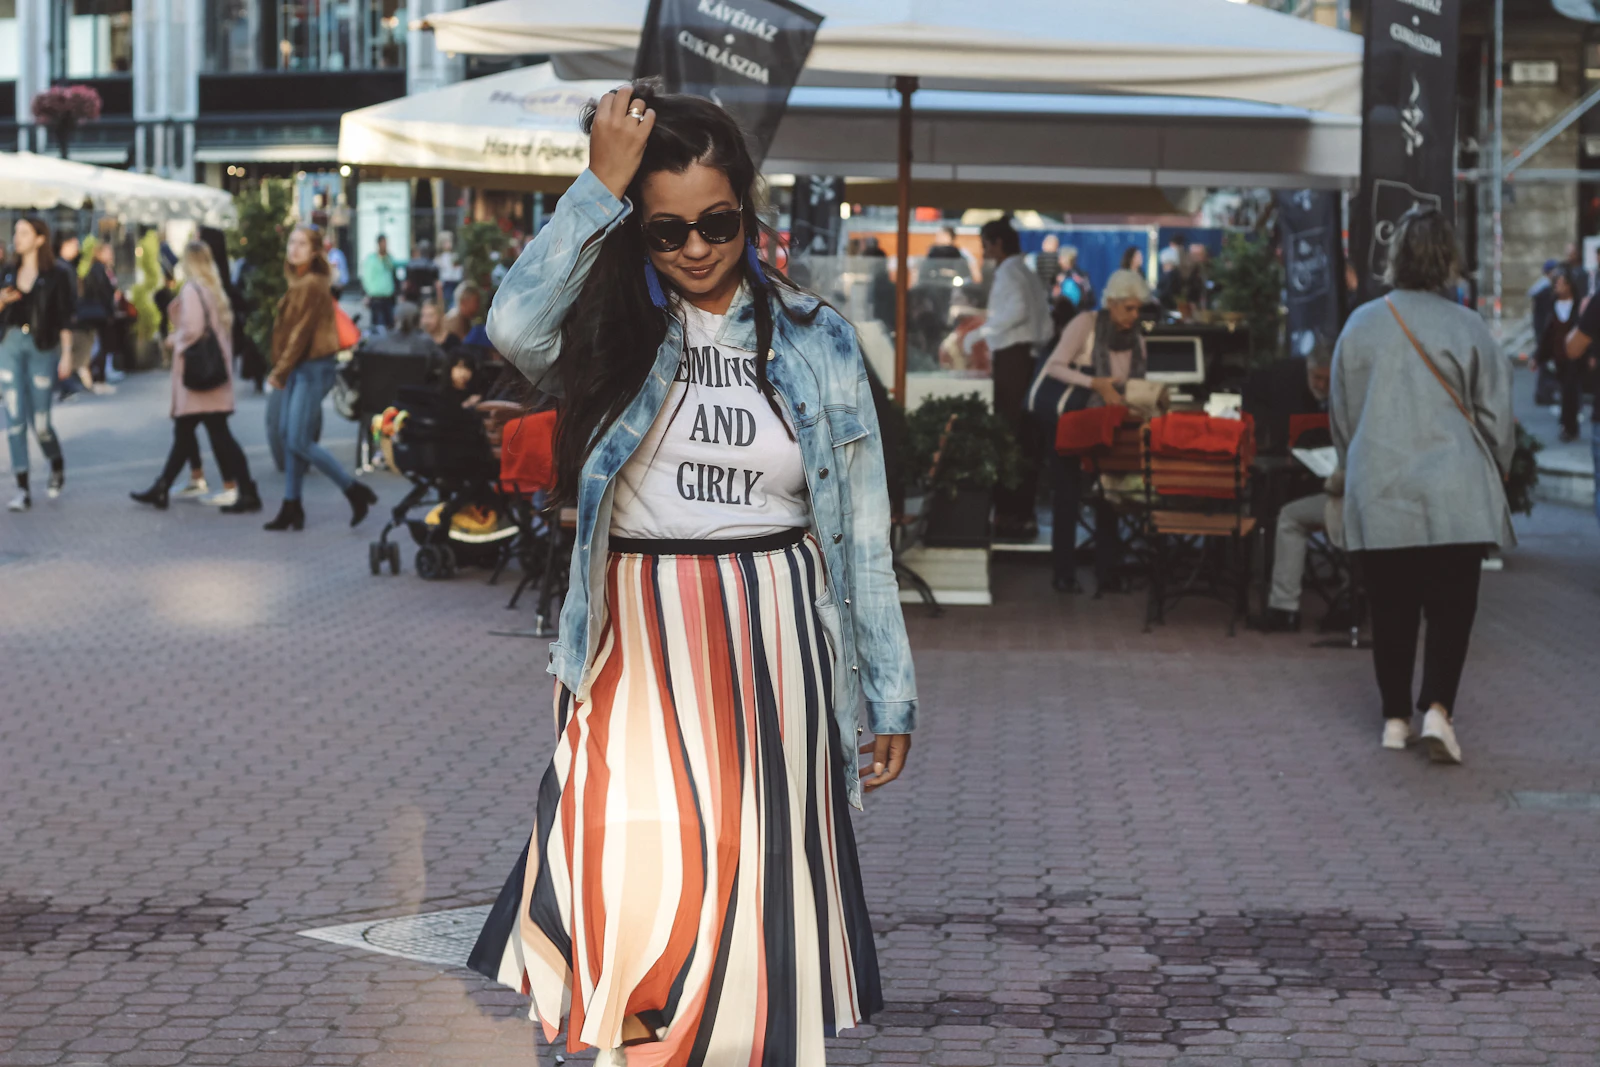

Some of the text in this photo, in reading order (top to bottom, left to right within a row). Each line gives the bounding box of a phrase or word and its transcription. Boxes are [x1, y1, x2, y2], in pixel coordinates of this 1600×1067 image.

[482, 135, 586, 162] Hard Rock
[689, 403, 757, 447] AND
[676, 461, 764, 506] GIRLY
